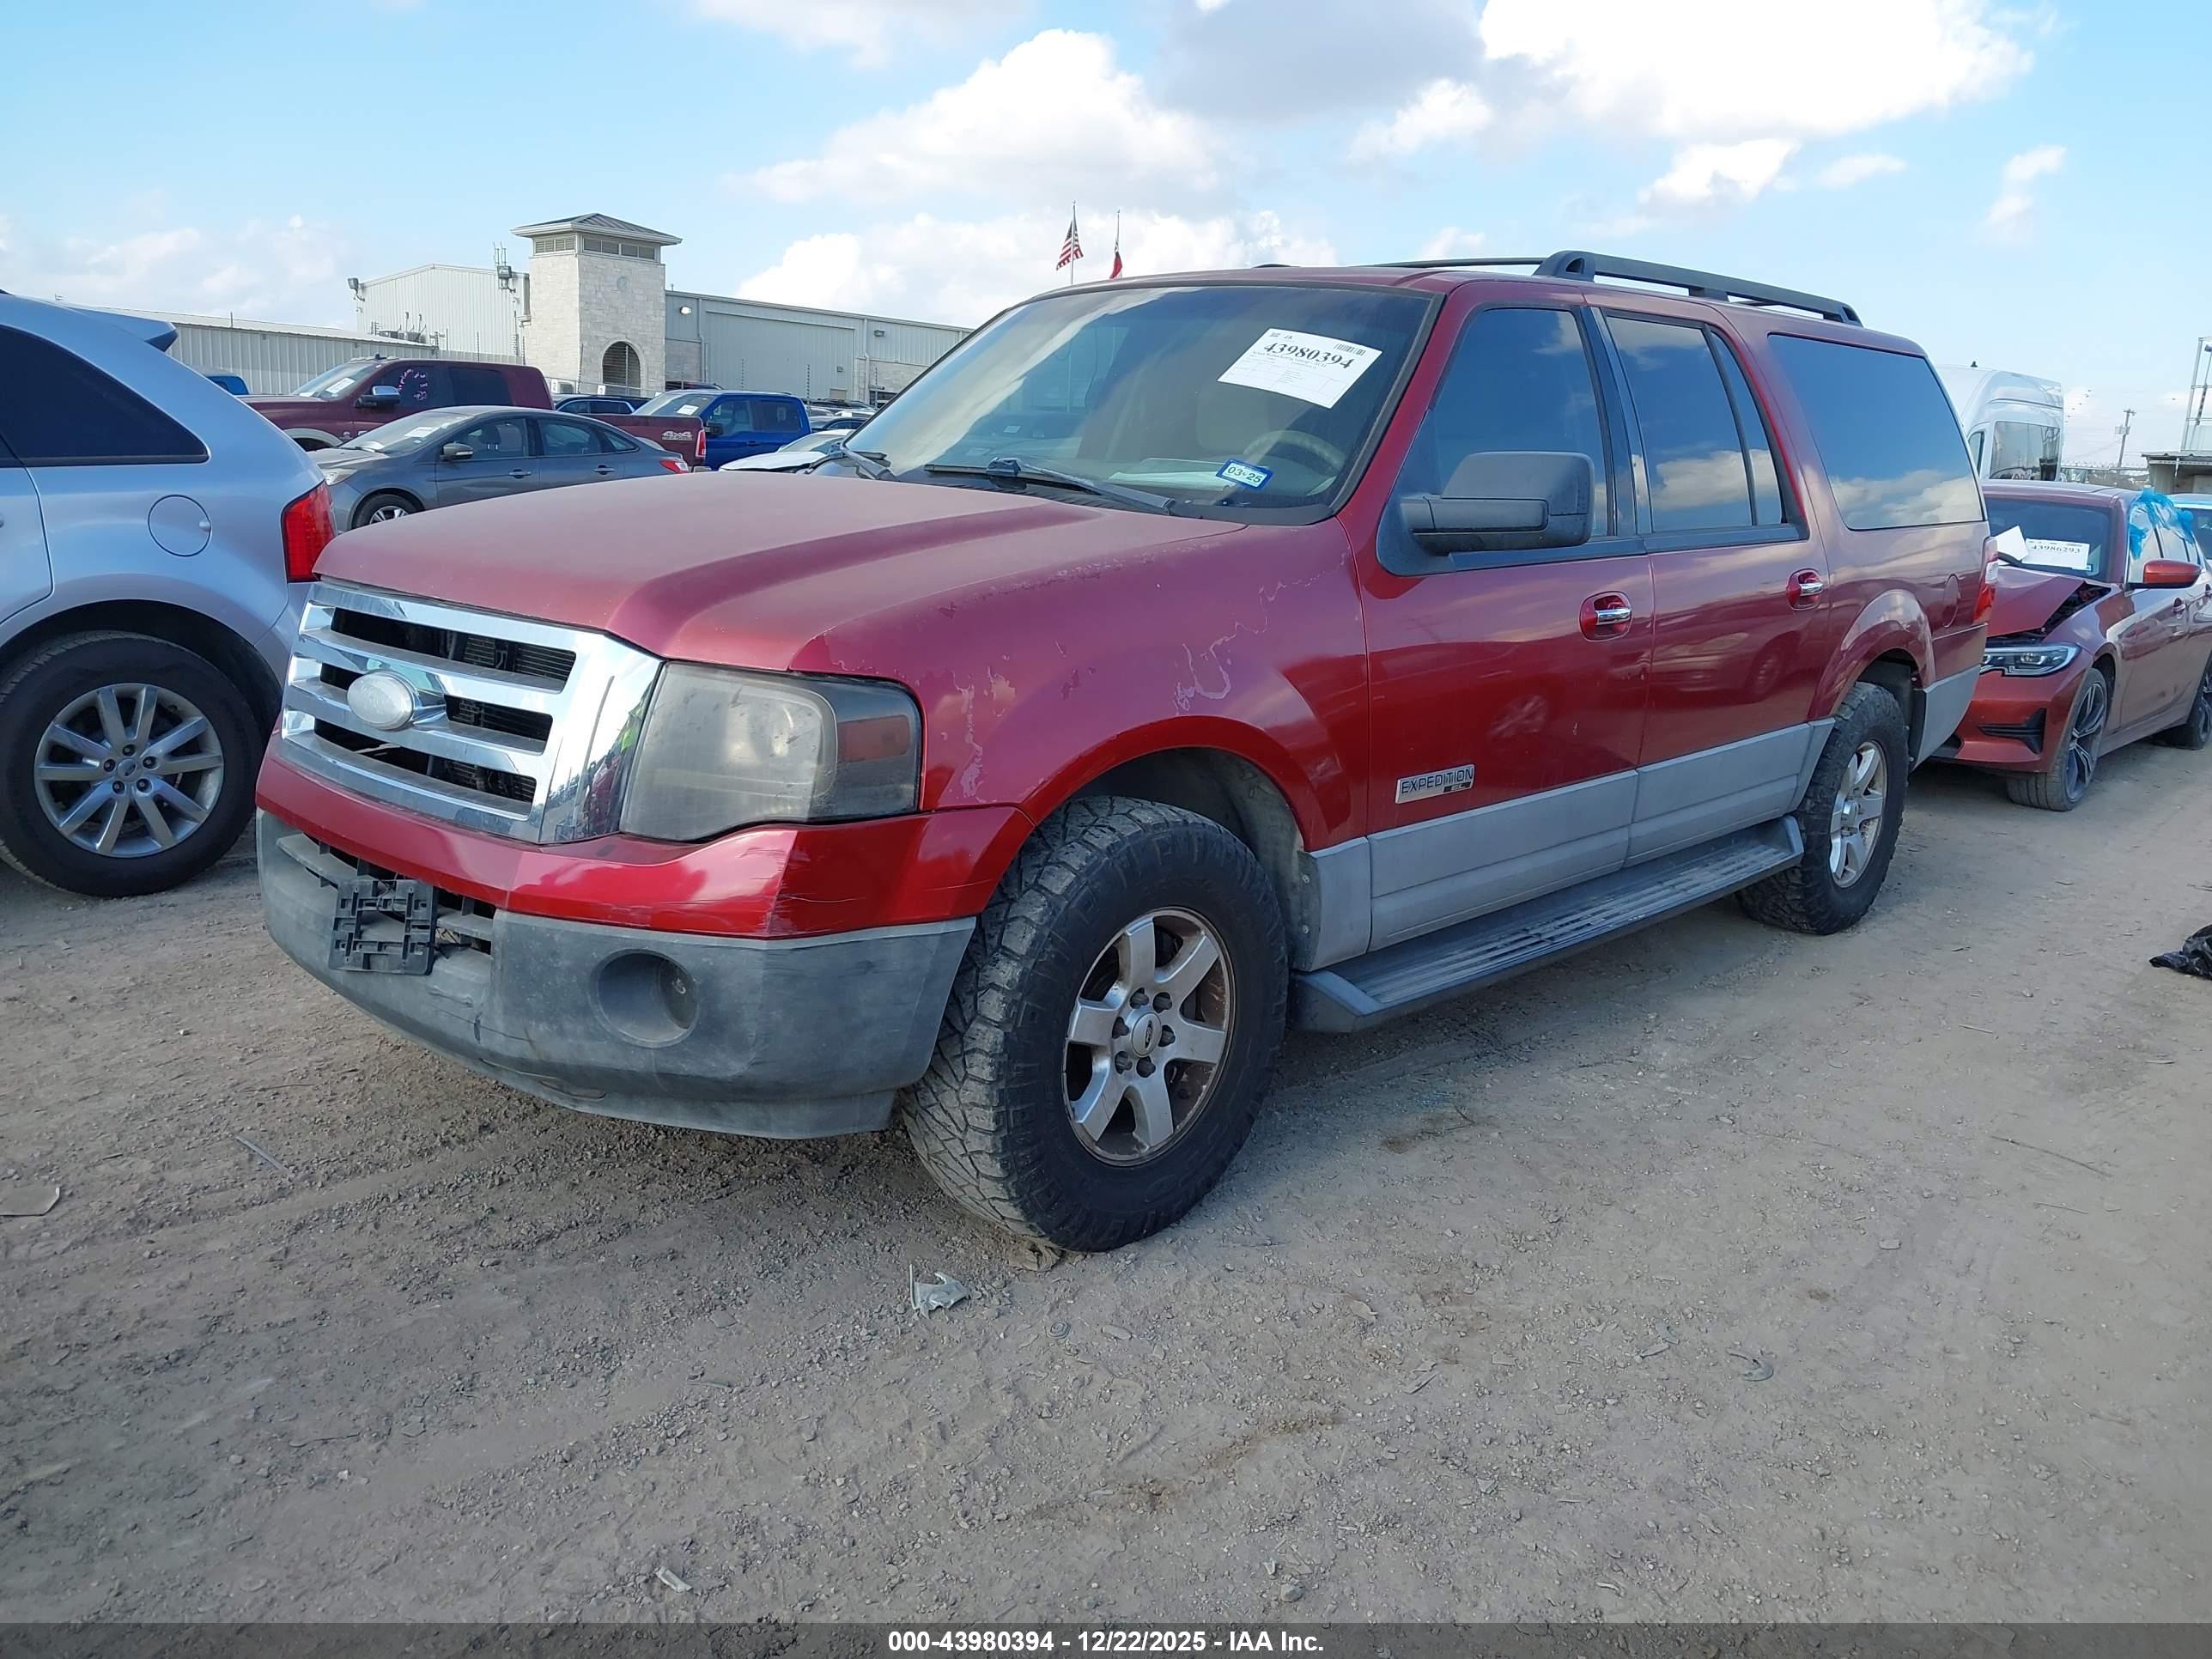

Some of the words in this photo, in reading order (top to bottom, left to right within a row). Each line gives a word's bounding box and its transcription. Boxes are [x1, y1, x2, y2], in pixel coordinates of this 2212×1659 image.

[1264, 342, 1355, 369] 43980394
[1228, 466, 1243, 477] 03
[1246, 472, 1263, 483] 25
[2032, 544, 2081, 553] 43986293
[1401, 768, 1473, 793] EXPEDITION
